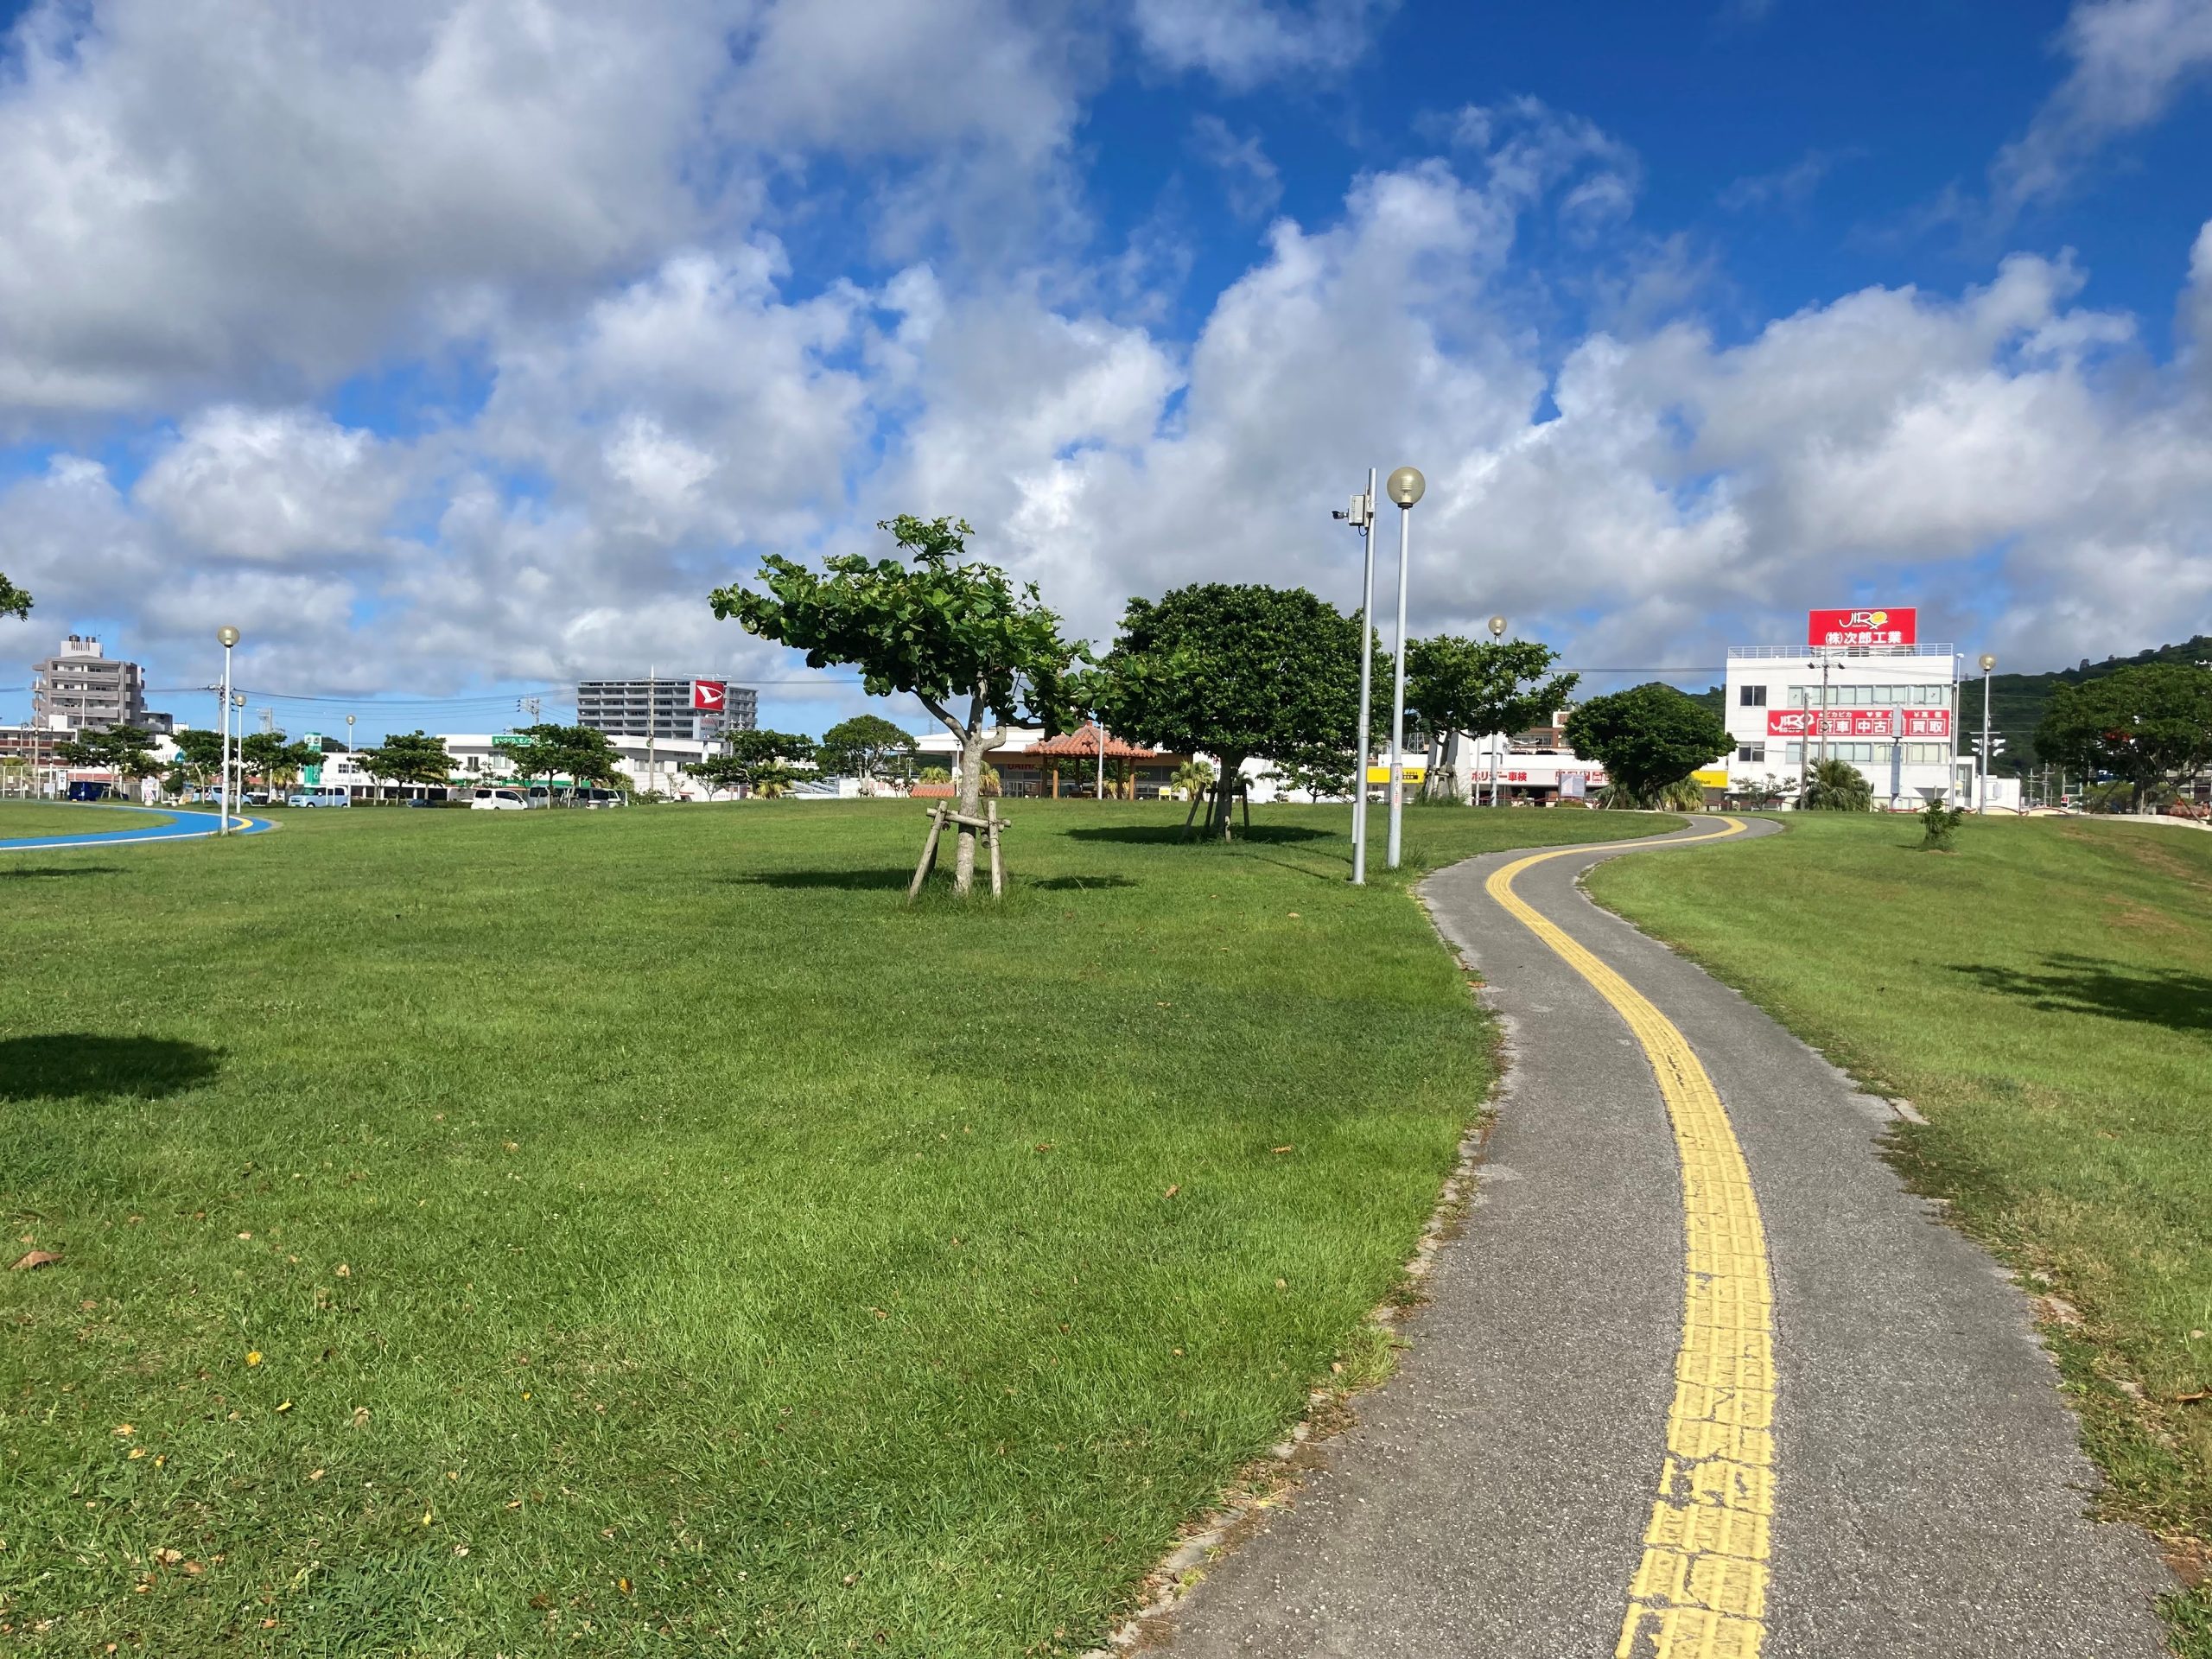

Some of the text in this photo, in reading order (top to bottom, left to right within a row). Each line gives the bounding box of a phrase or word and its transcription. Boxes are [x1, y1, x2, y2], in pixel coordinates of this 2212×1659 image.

[1826, 631, 1902, 645] (株)次郎工業
[1858, 720, 1905, 733] 中古
[1912, 721, 1943, 734] 買取
